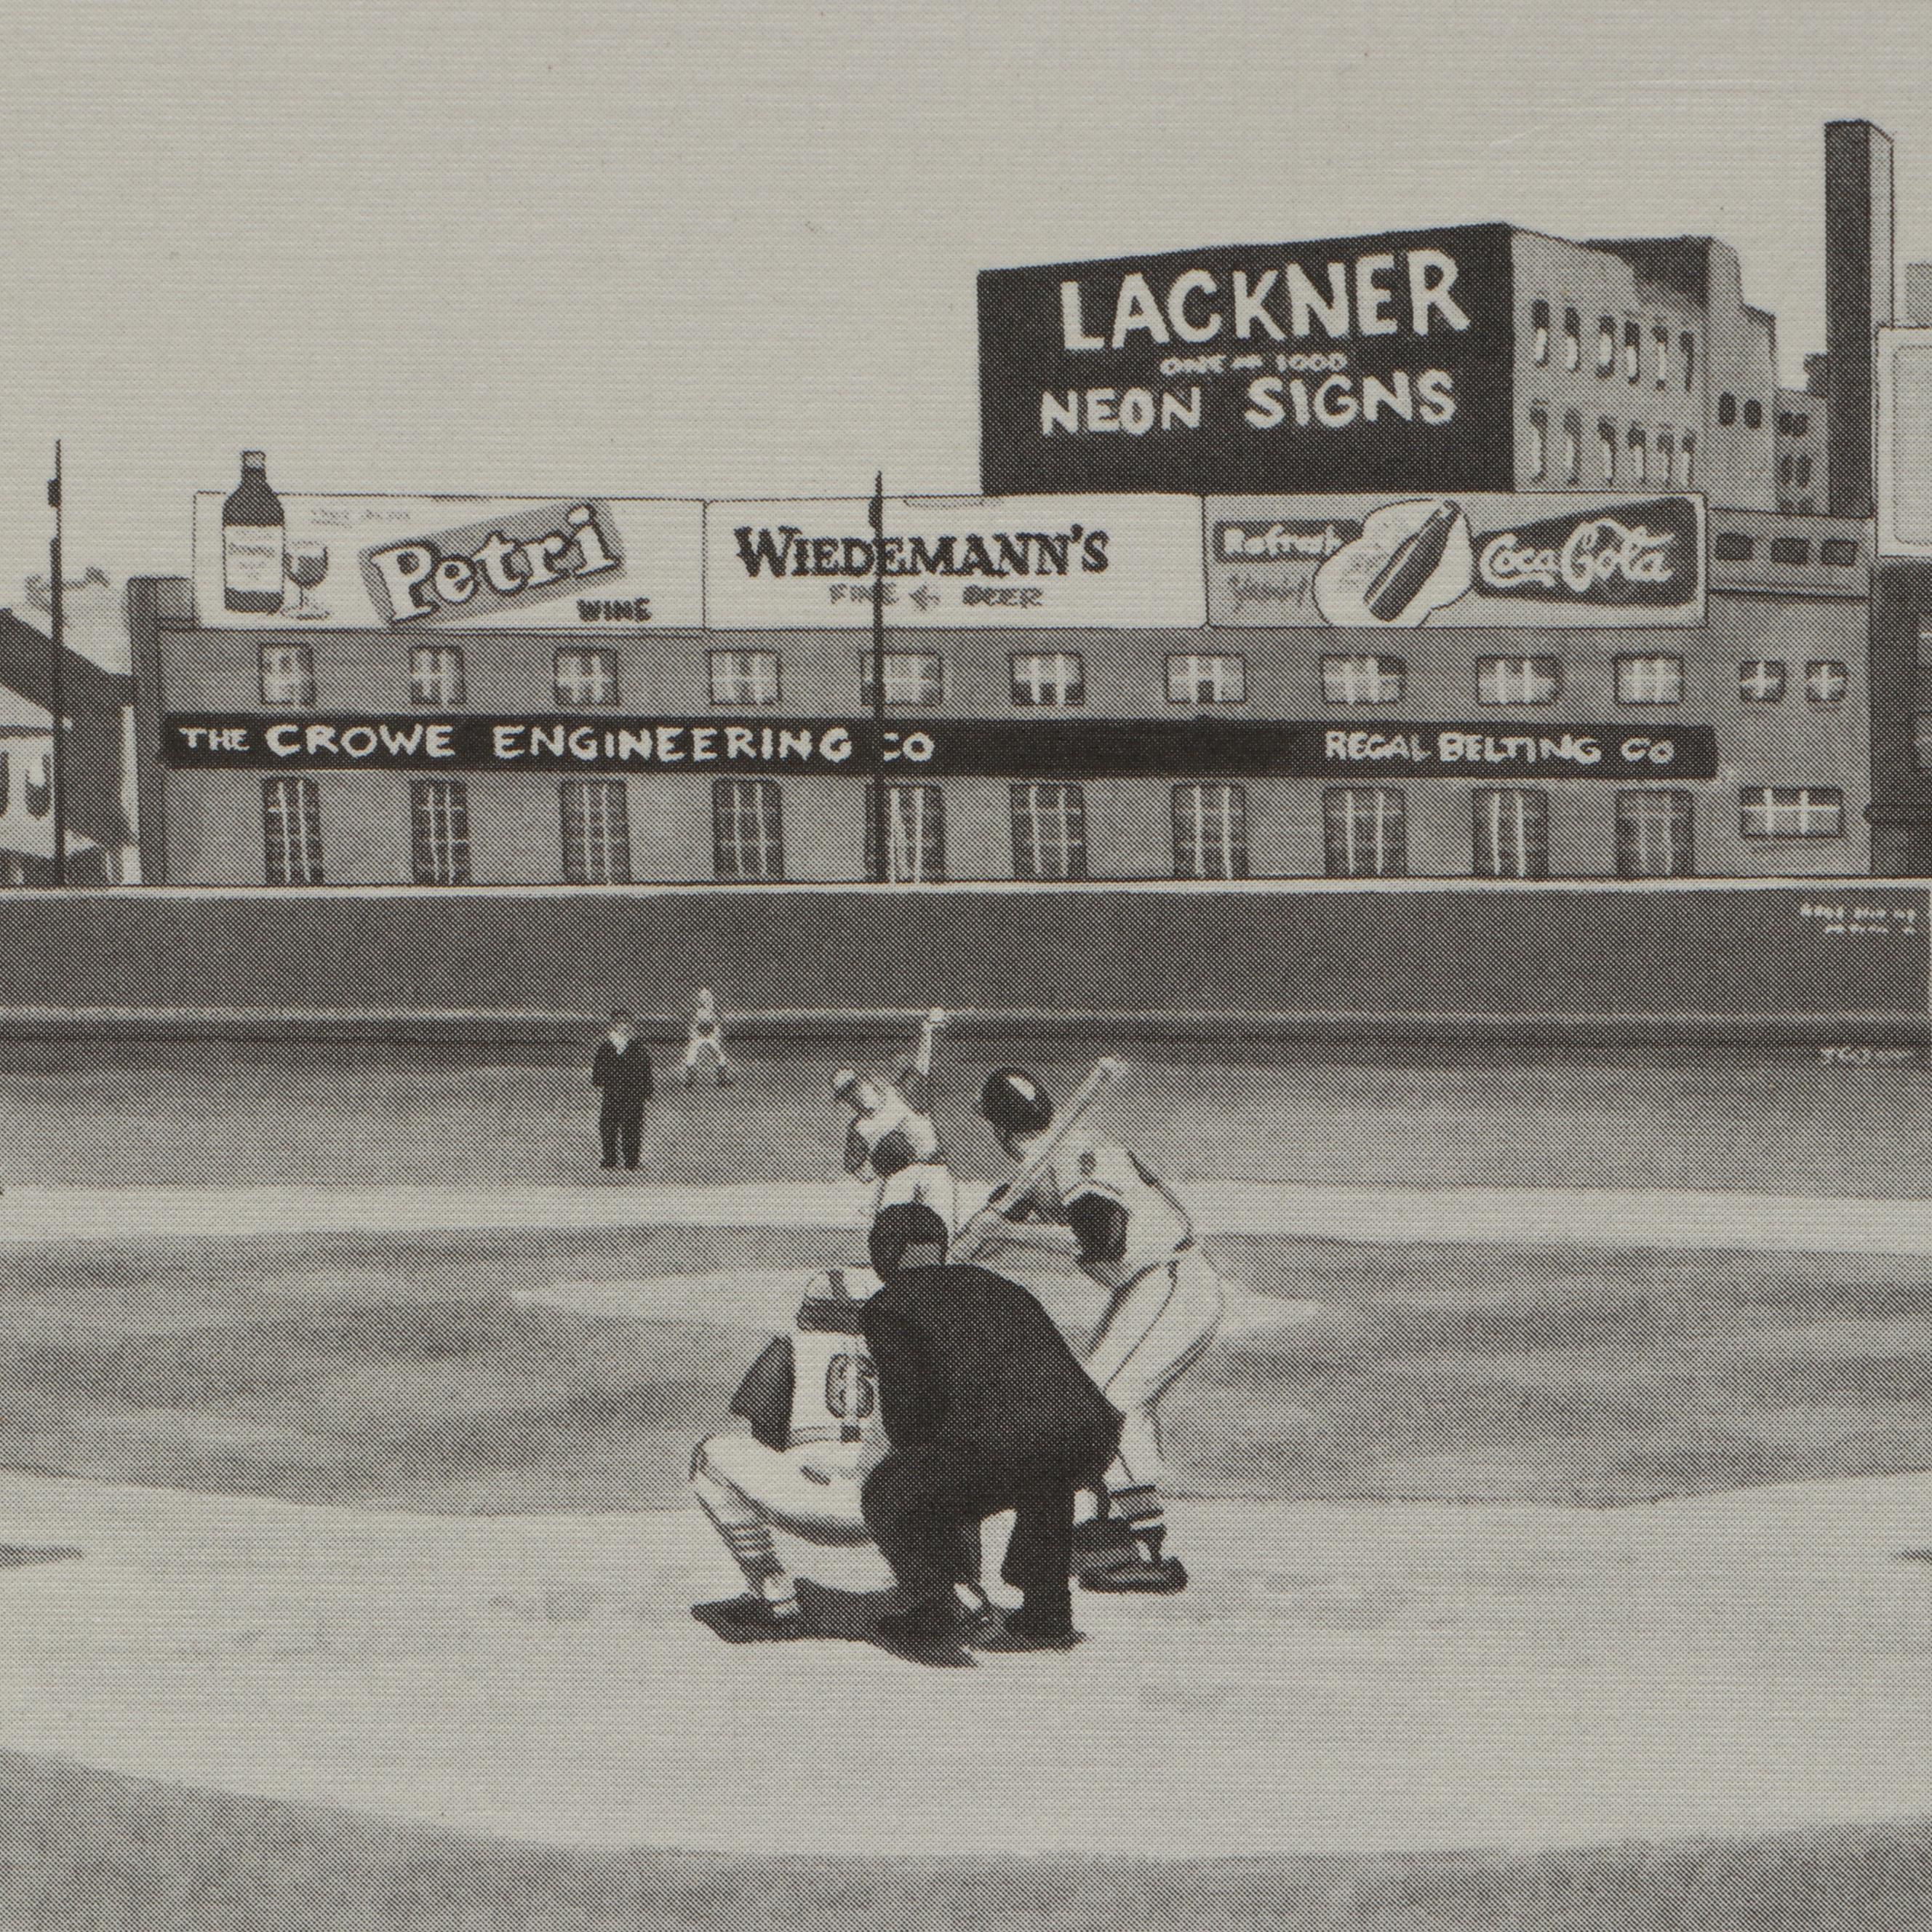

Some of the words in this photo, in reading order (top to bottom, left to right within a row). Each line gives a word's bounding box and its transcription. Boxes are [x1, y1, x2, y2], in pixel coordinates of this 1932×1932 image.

[1060, 249, 1471, 351] LACKNER
[1040, 386, 1202, 436] NEON
[1245, 370, 1456, 429] SIGNS
[366, 503, 618, 623] Petri
[733, 524, 1110, 578] WIEDEMANN'S
[577, 597, 652, 623] WINE
[962, 584, 1043, 608] BEER
[179, 727, 250, 751] THE
[264, 724, 455, 758] CROWE
[492, 724, 853, 763] ENGINEERING
[1325, 730, 1432, 762] REGAL
[1437, 732, 1602, 765] BELTING
[1620, 738, 1675, 764] CO
[825, 1352, 879, 1419] 6
